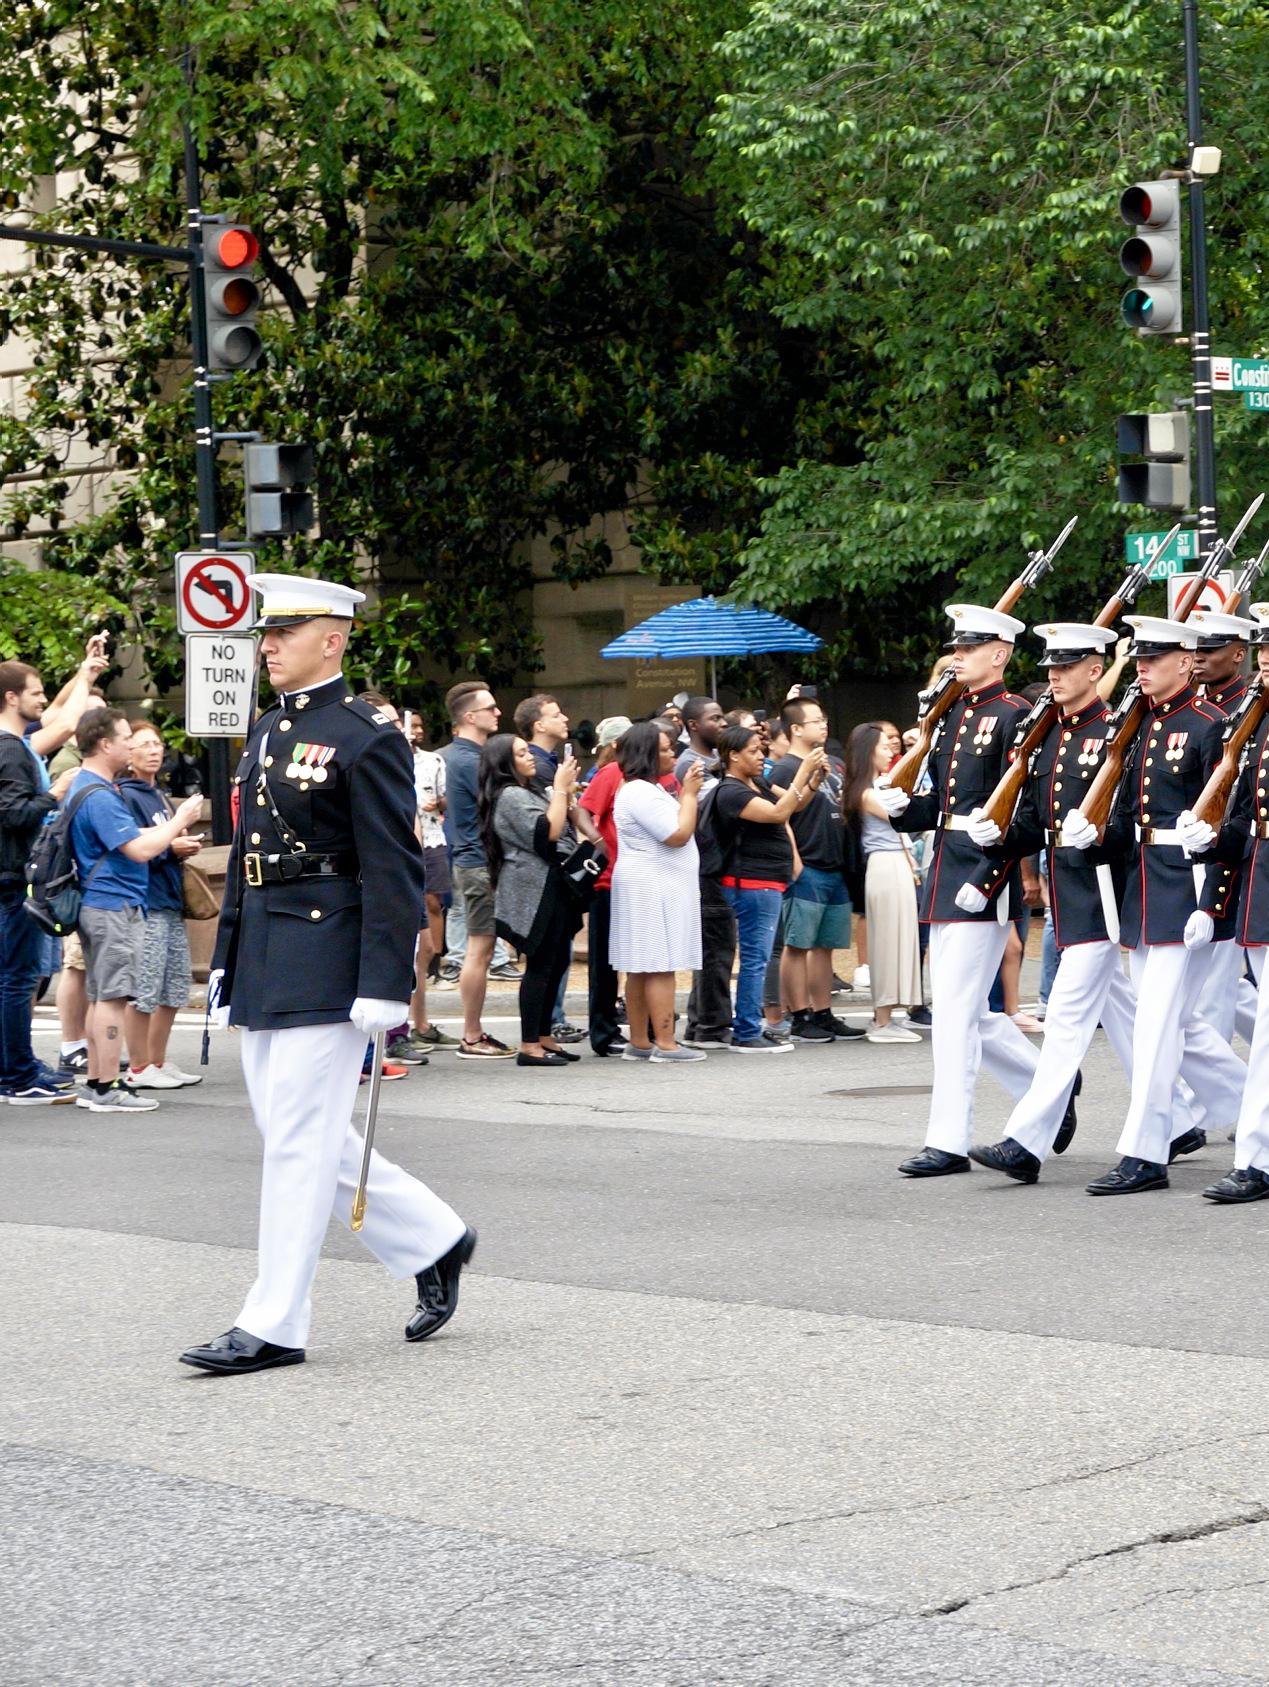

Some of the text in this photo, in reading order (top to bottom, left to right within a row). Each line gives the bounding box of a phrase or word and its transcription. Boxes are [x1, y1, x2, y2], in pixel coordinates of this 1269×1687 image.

[1134, 533, 1190, 559] 14 ST
[212, 645, 234, 660] NO
[202, 667, 245, 683] TURN
[213, 690, 236, 705] ON
[209, 712, 239, 727] RED
